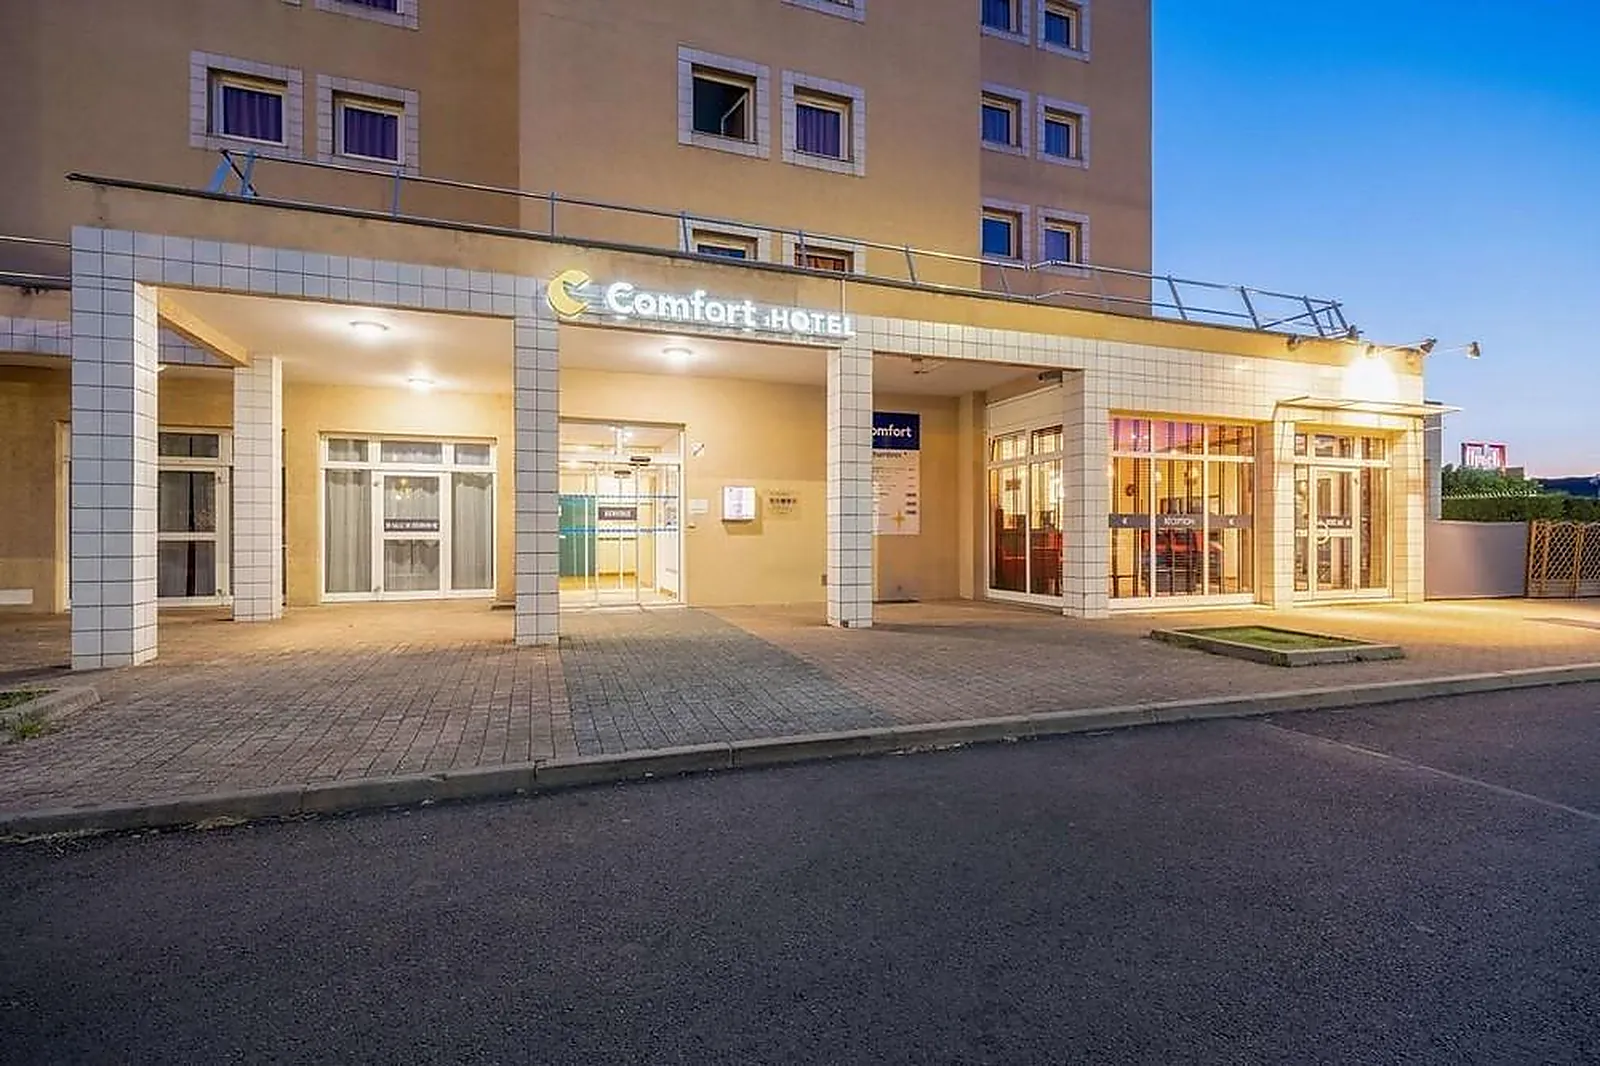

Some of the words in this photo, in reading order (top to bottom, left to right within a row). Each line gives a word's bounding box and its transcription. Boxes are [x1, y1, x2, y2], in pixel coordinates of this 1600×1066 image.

[606, 281, 757, 328] Comfort
[771, 308, 856, 336] HOTEL
[872, 424, 912, 438] omfort
